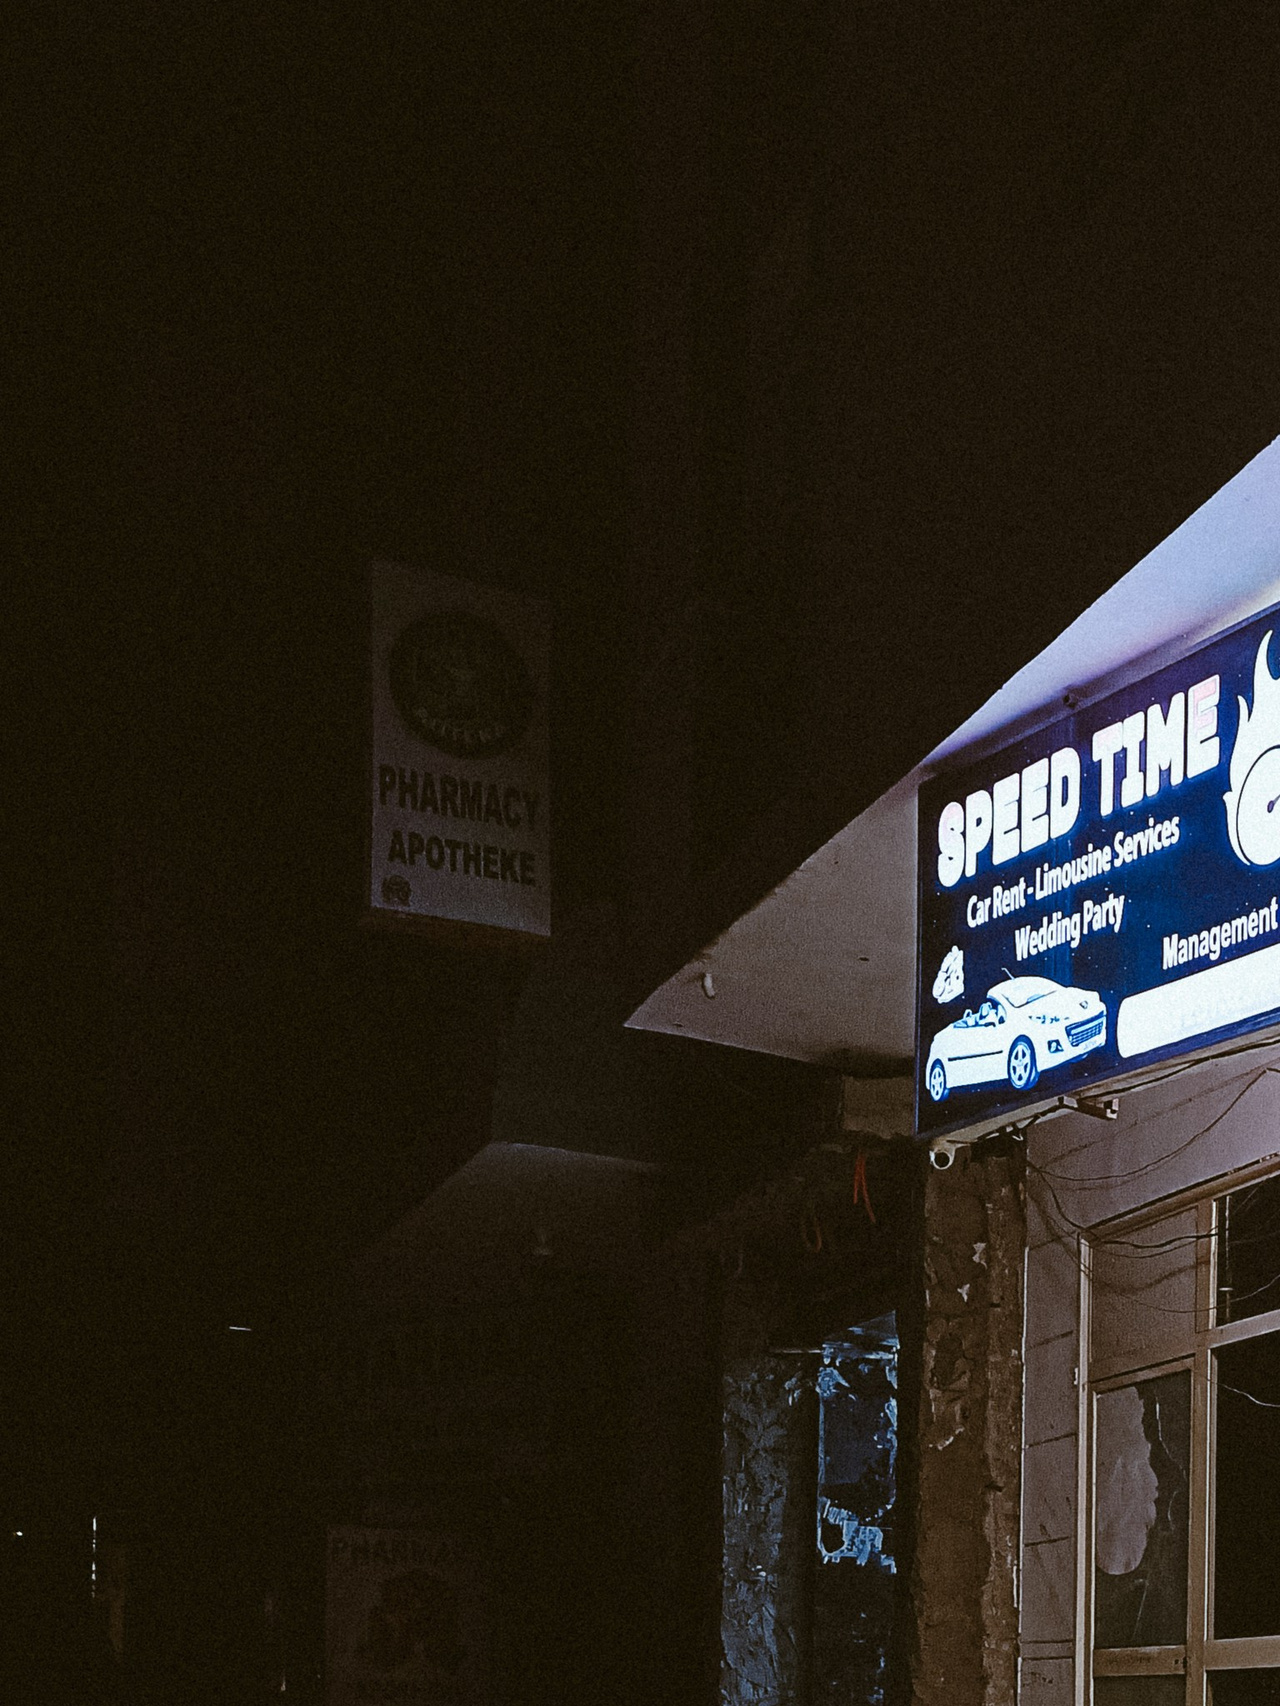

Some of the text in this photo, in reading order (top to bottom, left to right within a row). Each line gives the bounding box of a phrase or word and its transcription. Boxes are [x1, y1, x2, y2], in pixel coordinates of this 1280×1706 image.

[378, 764, 540, 828] PHARMACY
[937, 674, 1222, 888] SPEED TIME
[388, 828, 537, 887] APOTHEKE
[967, 896, 993, 928] Car
[993, 879, 1027, 918] Rent
[1035, 842, 1114, 902] Limousine
[1114, 816, 1180, 868] Services
[1014, 892, 1126, 962] Wedding Party
[1162, 900, 1279, 970] Management
